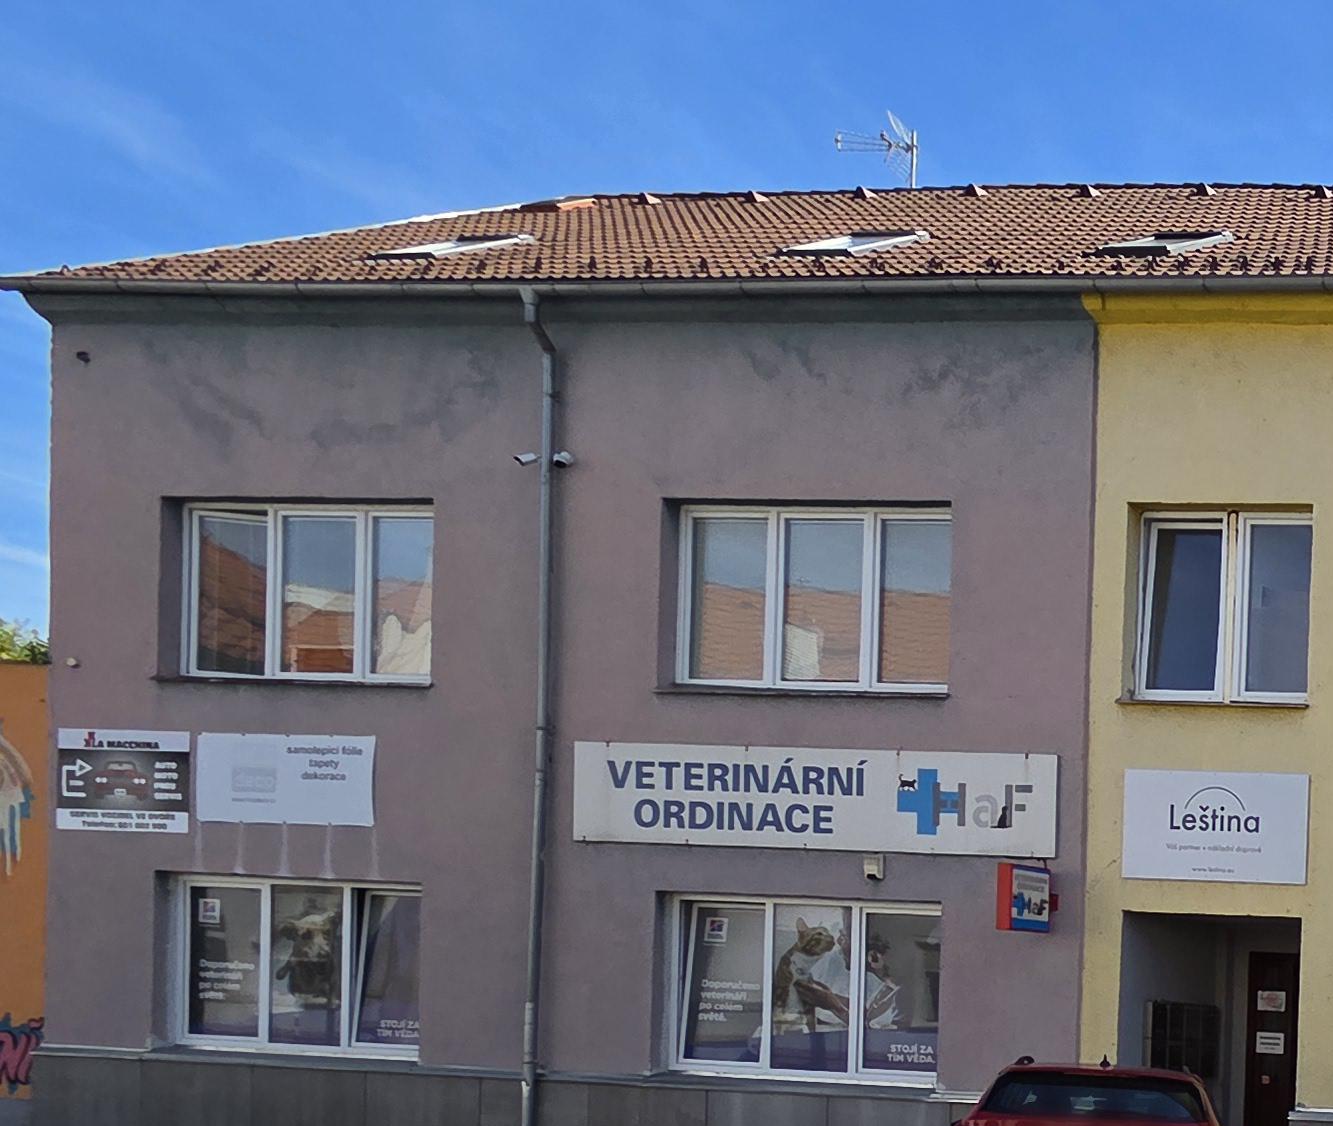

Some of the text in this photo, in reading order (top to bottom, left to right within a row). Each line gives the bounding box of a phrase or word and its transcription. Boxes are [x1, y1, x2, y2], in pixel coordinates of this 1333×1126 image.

[607, 758, 868, 797] VETERINÁRNÍ
[634, 798, 834, 835] ORDINACE
[1169, 804, 1261, 833] Leština
[890, 1043, 934, 1054] STOJÍ ZA
